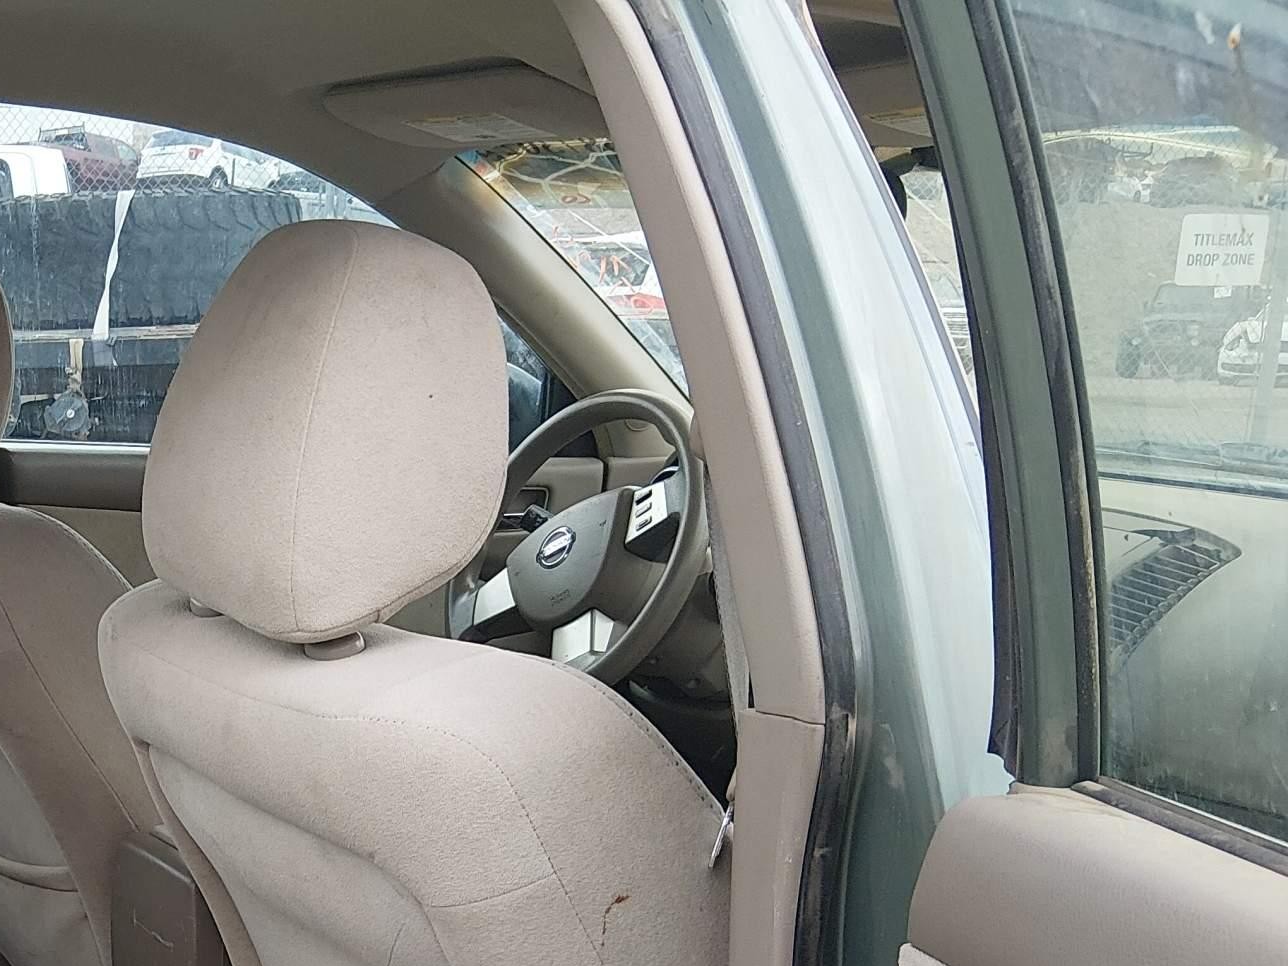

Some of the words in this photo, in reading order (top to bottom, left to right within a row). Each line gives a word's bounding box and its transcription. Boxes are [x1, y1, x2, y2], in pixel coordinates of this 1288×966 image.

[1193, 233, 1254, 246] TITLEMAX
[1187, 253, 1220, 266] DROP
[1222, 253, 1255, 266] ZONE
